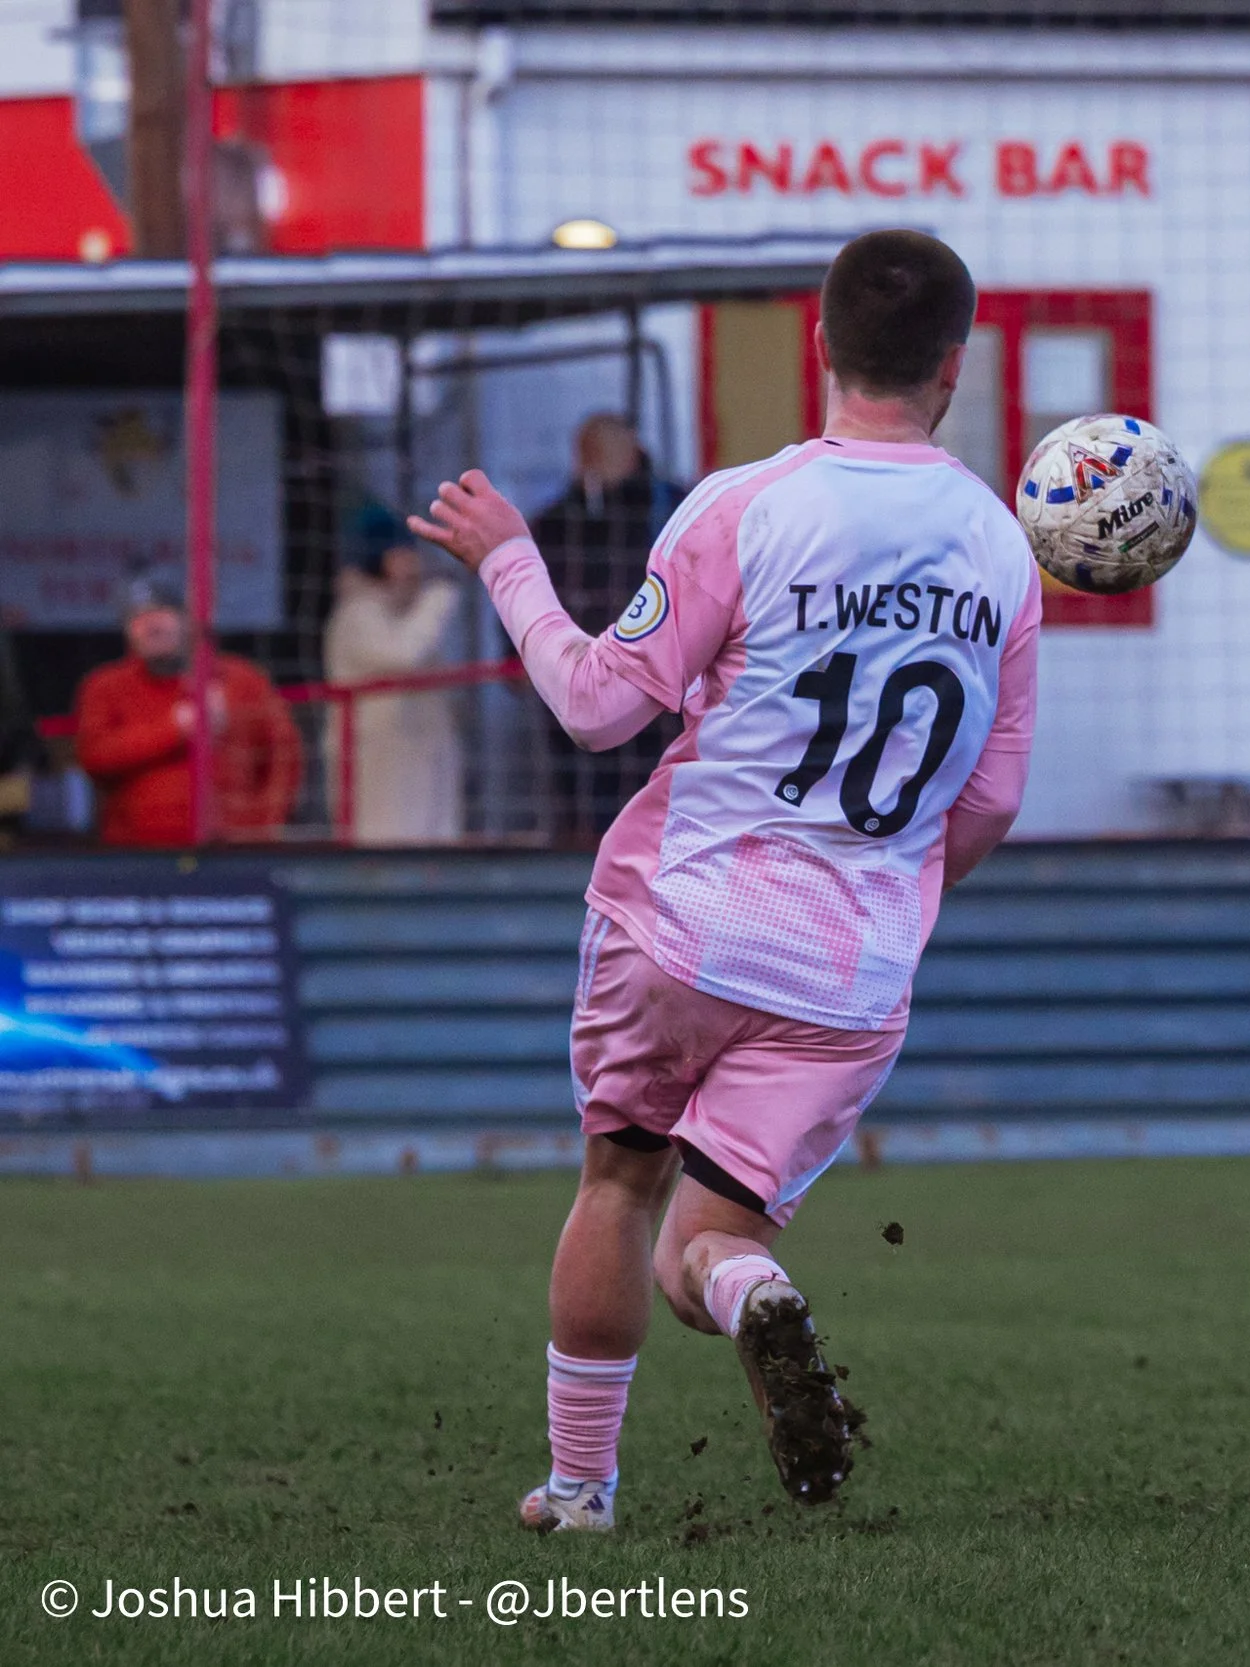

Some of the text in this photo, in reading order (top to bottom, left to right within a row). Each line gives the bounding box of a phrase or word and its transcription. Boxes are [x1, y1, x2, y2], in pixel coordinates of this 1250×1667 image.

[689, 138, 1150, 198] SNACK BAR
[1098, 491, 1154, 540] Mitre
[789, 582, 1000, 648] T.WESTON
[774, 651, 966, 838] 10
